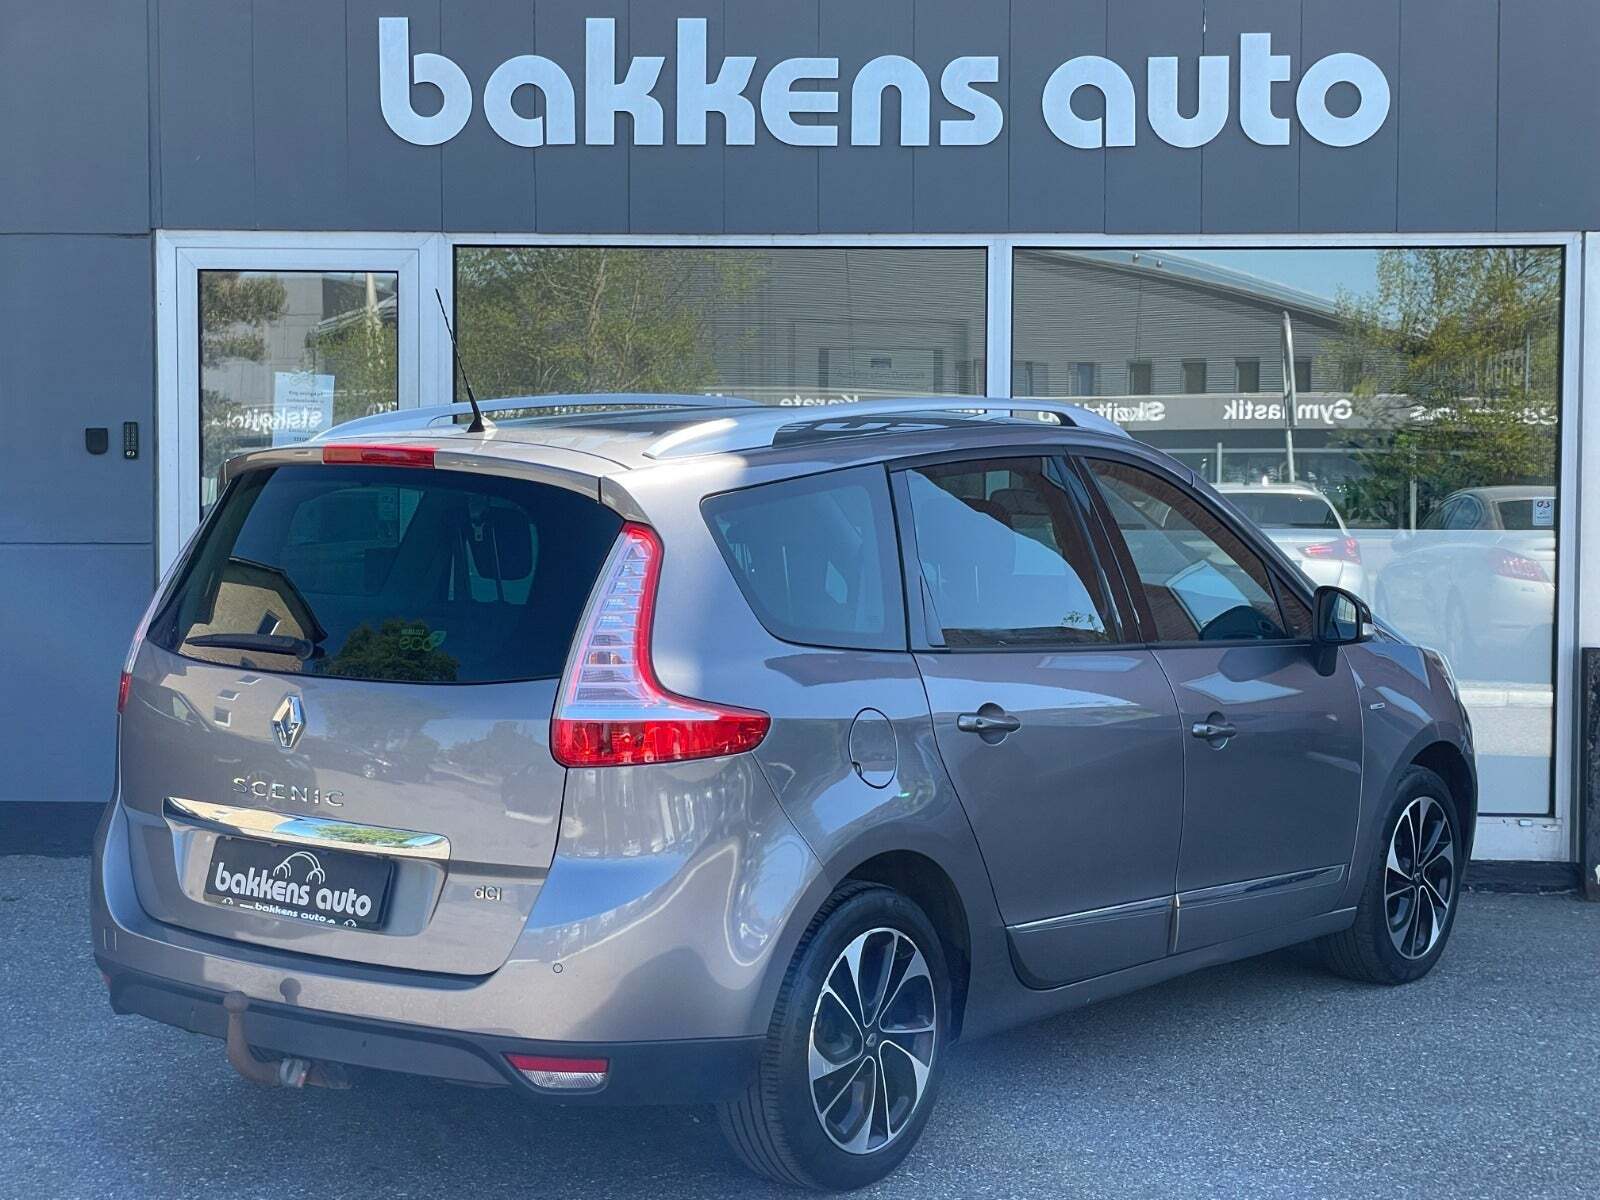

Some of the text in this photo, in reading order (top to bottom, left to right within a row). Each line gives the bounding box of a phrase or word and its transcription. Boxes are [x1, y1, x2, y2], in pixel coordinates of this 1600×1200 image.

[379, 16, 1391, 149] bakkens auto
[232, 777, 344, 807] SCENIC
[215, 862, 372, 917] bakkens auto
[254, 902, 326, 922] bakkens auto
